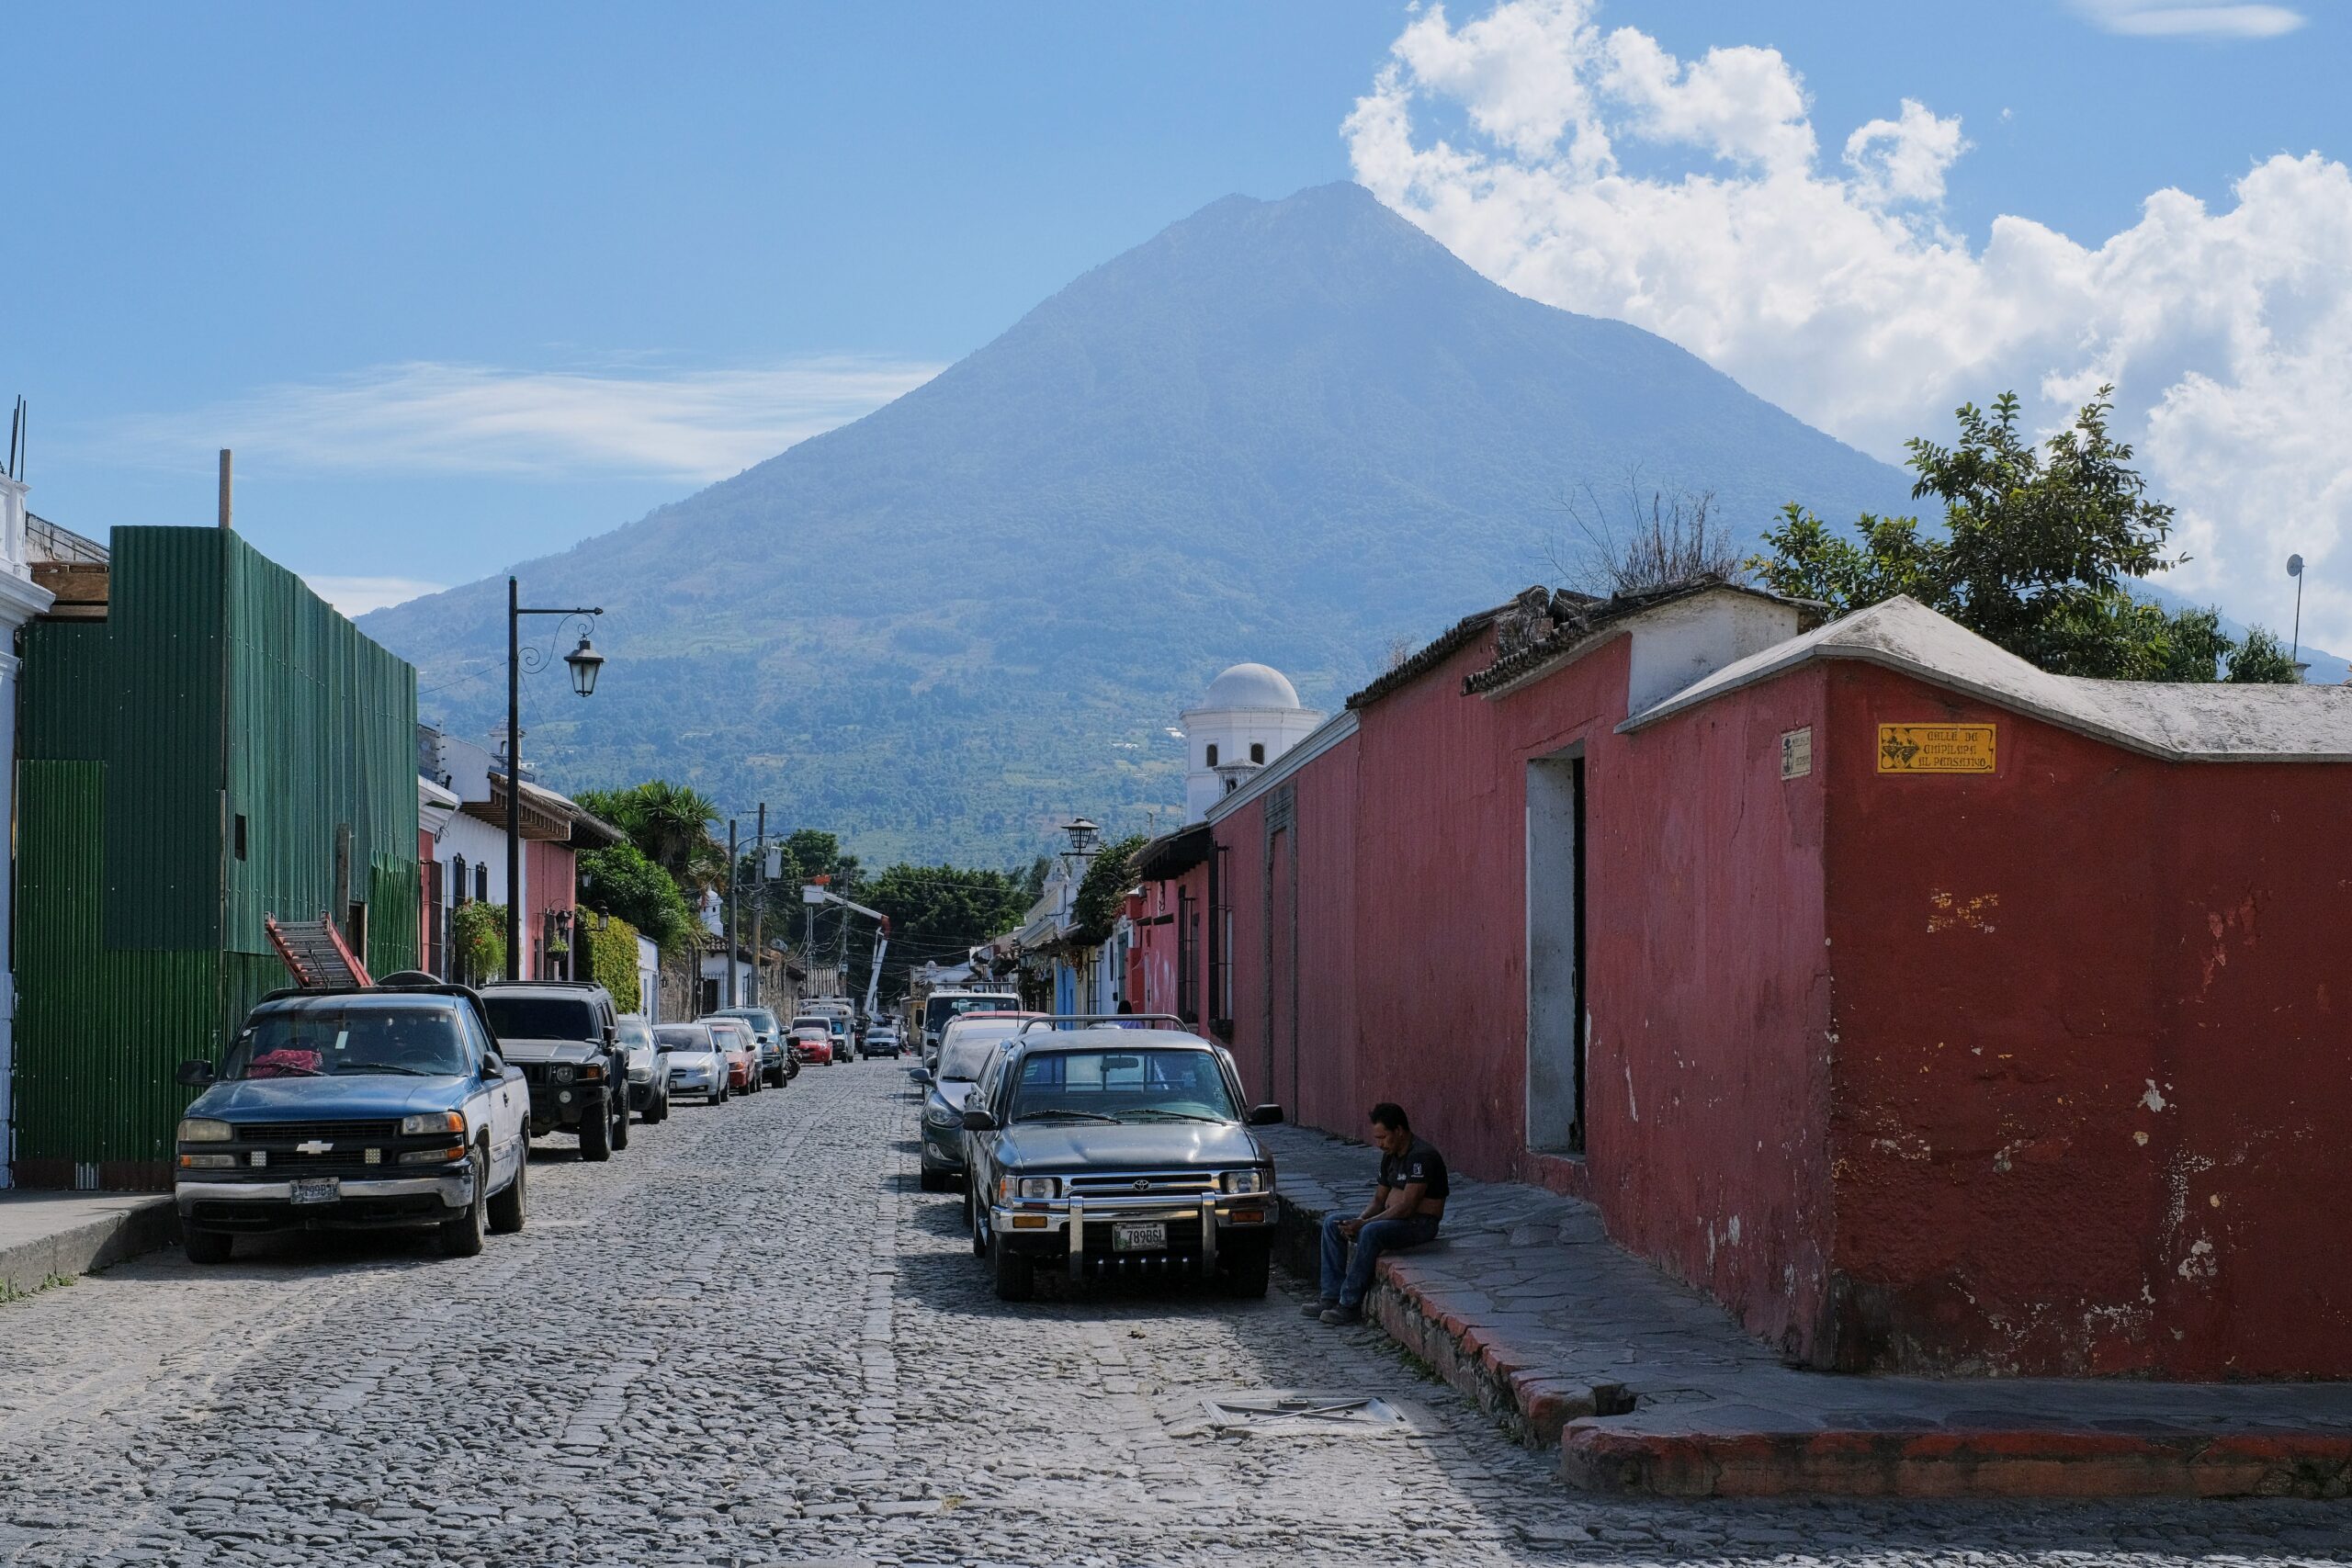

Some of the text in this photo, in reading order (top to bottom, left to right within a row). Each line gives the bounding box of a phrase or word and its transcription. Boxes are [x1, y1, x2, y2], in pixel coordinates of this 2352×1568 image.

[1927, 731, 1978, 741] CALLE DE
[1918, 757, 1986, 767] EL PENSATIVO
